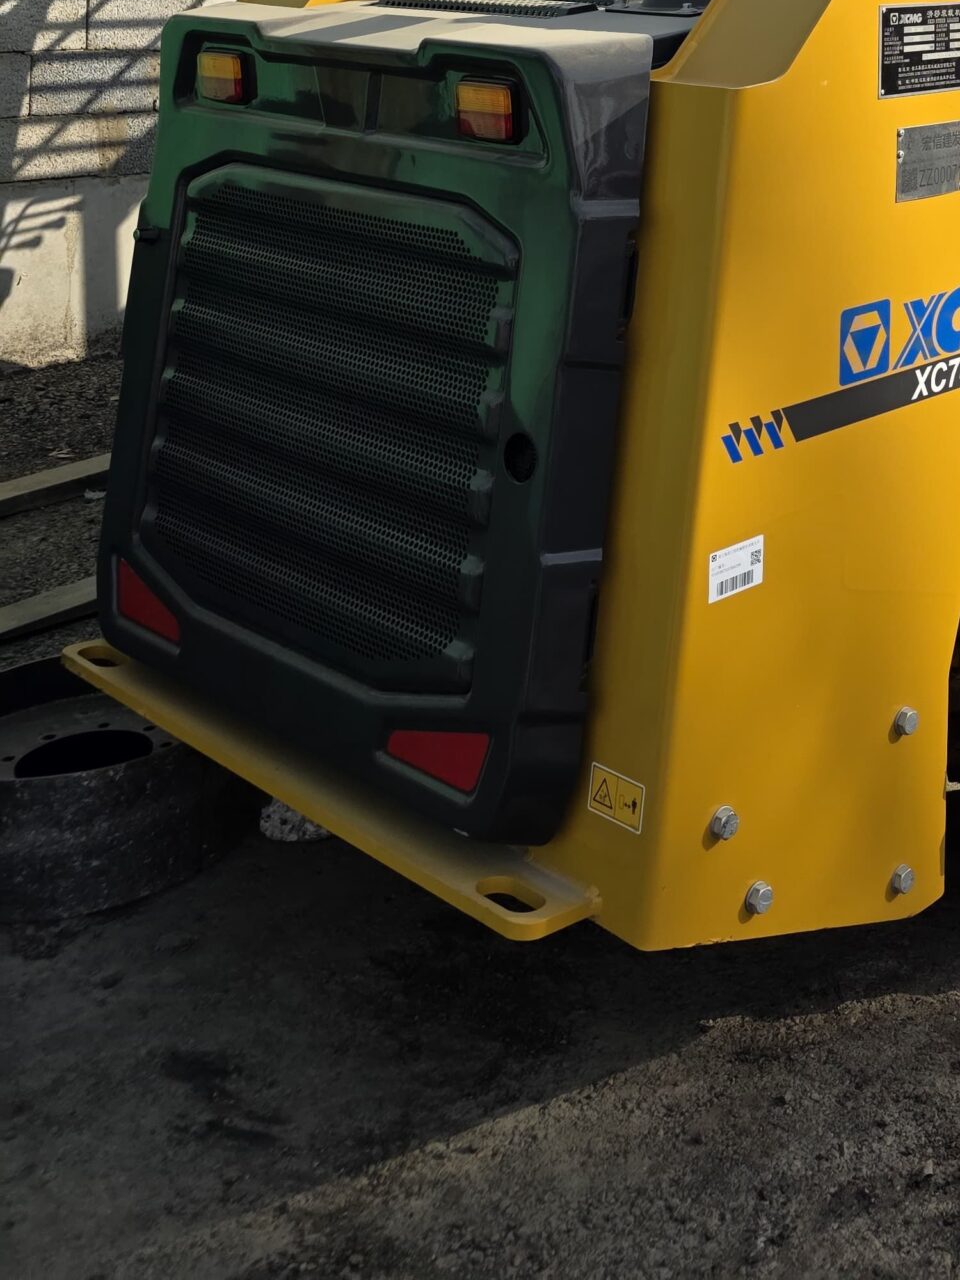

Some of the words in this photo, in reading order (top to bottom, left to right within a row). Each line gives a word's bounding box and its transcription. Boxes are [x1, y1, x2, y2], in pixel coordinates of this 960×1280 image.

[899, 13, 923, 24] XCMG
[921, 129, 960, 152] 宏信建发
